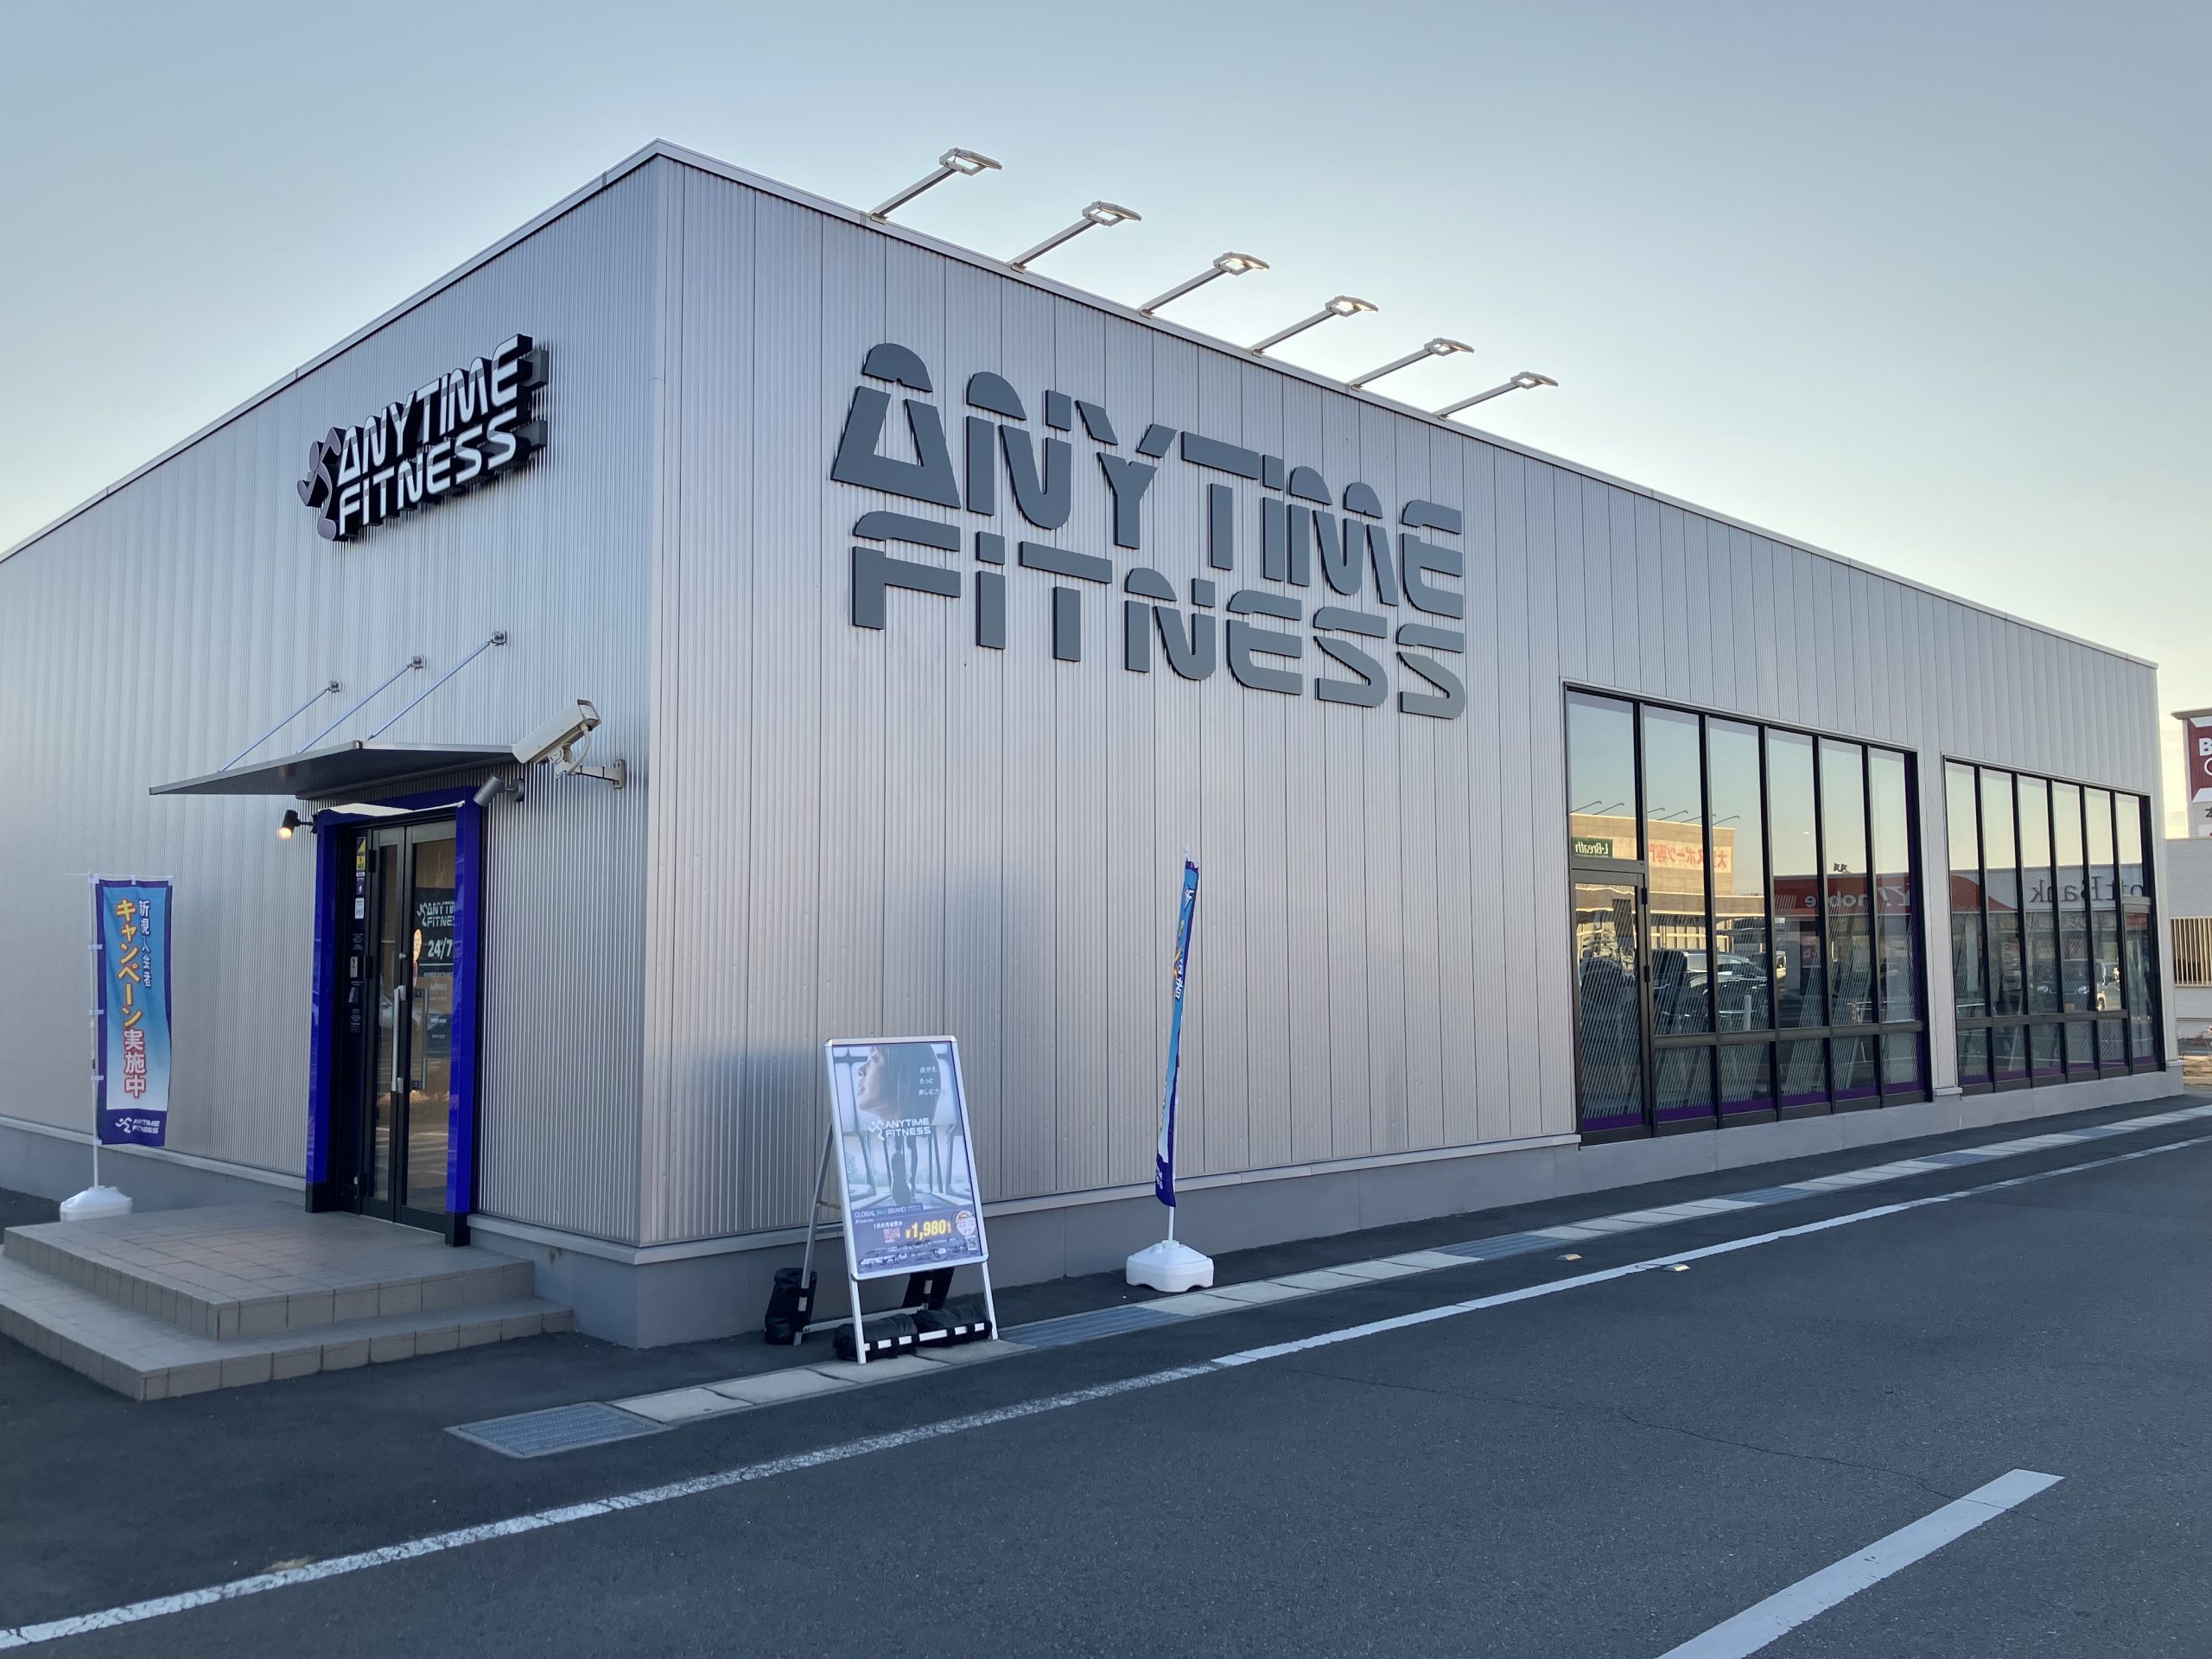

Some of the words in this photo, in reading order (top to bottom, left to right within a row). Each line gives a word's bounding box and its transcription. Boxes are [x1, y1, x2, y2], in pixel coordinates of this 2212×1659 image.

[337, 334, 520, 486] ANYTIME
[340, 407, 518, 536] FITNESS
[831, 343, 1464, 619] ANYTIME
[851, 511, 1466, 719] FITNESS
[117, 899, 146, 1098] キャンペーン実施中
[428, 938, 453, 959] 24/7
[885, 1116, 930, 1128] ANYTIME
[885, 1126, 931, 1138] FITNESS
[854, 1210, 876, 1218] GLOBAL
